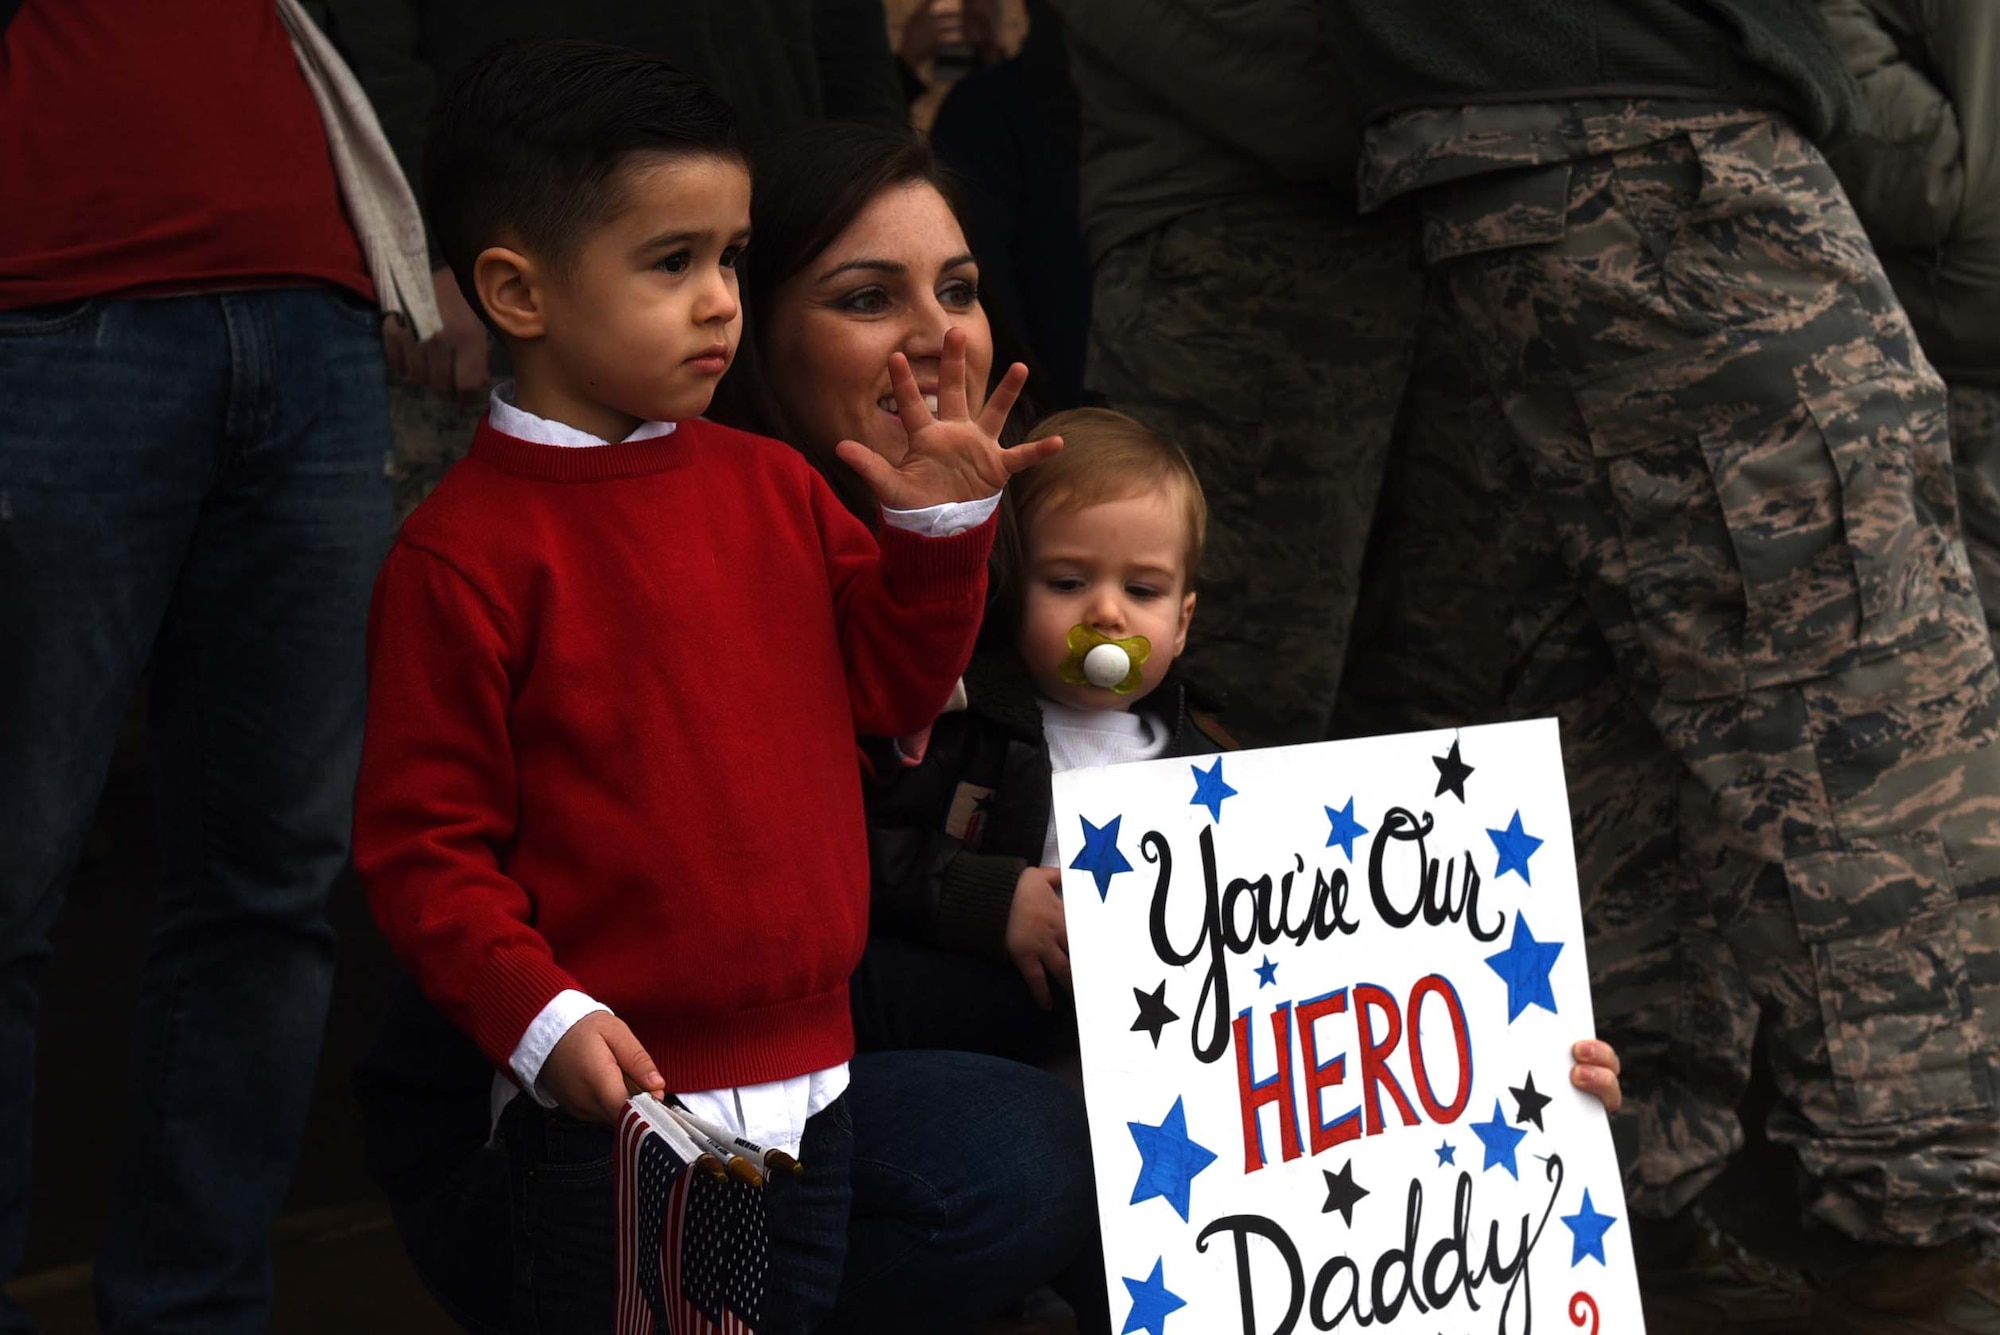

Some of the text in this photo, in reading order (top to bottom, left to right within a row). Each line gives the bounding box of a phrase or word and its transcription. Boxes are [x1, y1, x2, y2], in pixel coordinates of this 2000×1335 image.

[1141, 806, 1506, 1064] You're Our
[1232, 973, 1474, 1174] HERO
[1196, 1154, 1564, 1335] Daddy
